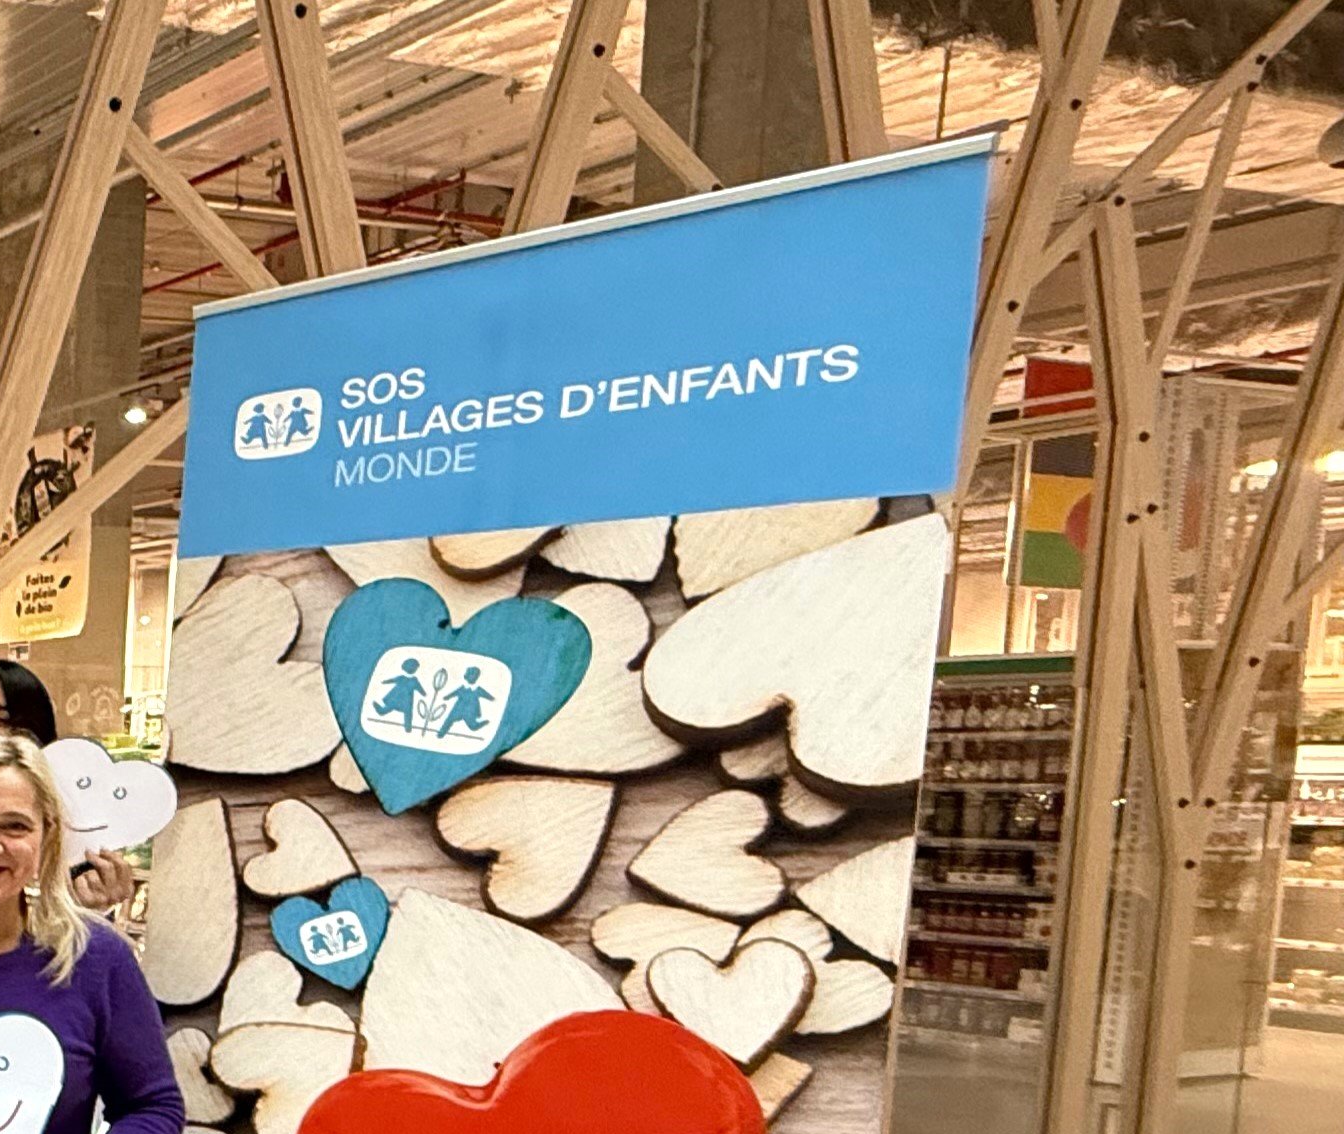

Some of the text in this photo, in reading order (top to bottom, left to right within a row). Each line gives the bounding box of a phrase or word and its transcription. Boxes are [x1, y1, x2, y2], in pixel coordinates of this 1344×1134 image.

[337, 343, 860, 448] VILLAGES D'ENFANTS
[340, 367, 426, 409] SOS
[333, 442, 478, 487] MONDE
[25, 602, 53, 615] de bio
[32, 588, 57, 602] plein
